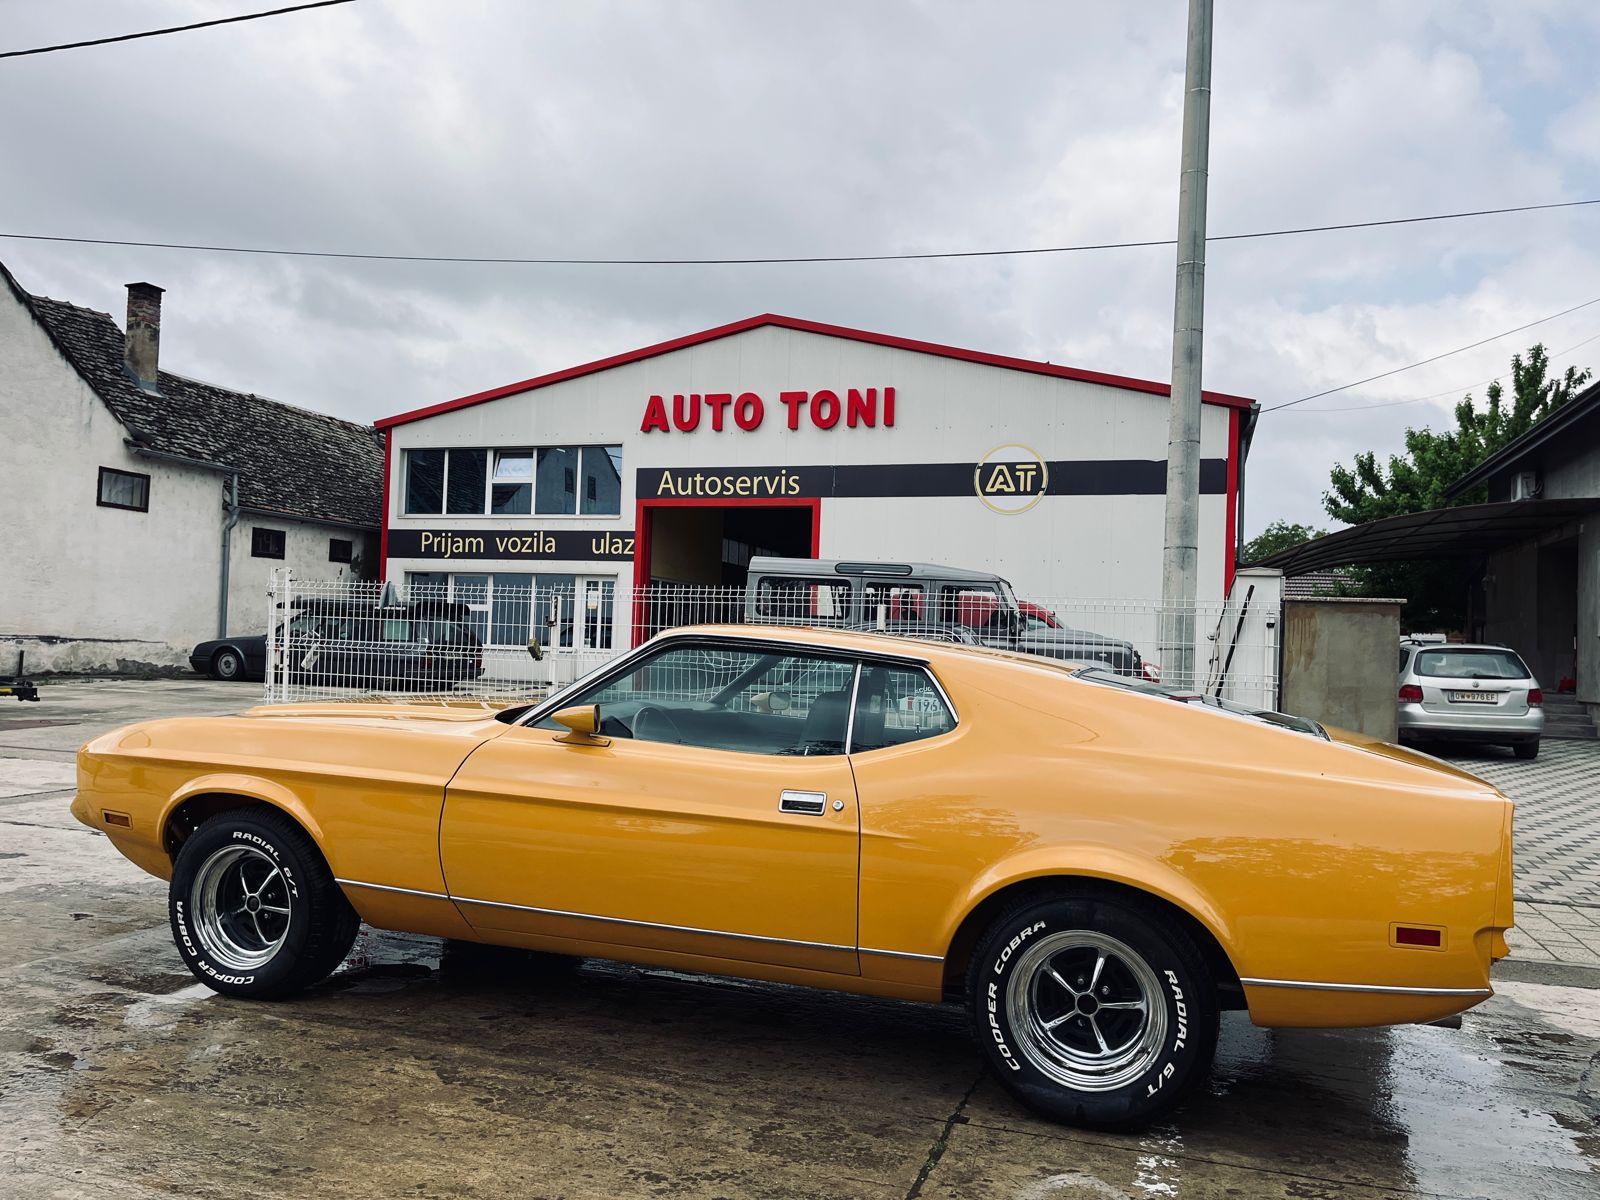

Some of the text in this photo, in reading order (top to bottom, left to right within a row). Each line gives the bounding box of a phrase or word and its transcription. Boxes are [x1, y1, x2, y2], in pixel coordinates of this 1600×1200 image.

[641, 387, 896, 432] AUTO TONI
[657, 469, 800, 496] Autoservis
[985, 464, 1037, 492] AT
[420, 531, 634, 558] Prijam vozila ulaz
[232, 831, 281, 862] RADIAL
[176, 900, 255, 985] COOPER COBRA
[987, 920, 1047, 1071] COOPER COBRA
[1146, 969, 1188, 1099] RADIAL G/T
